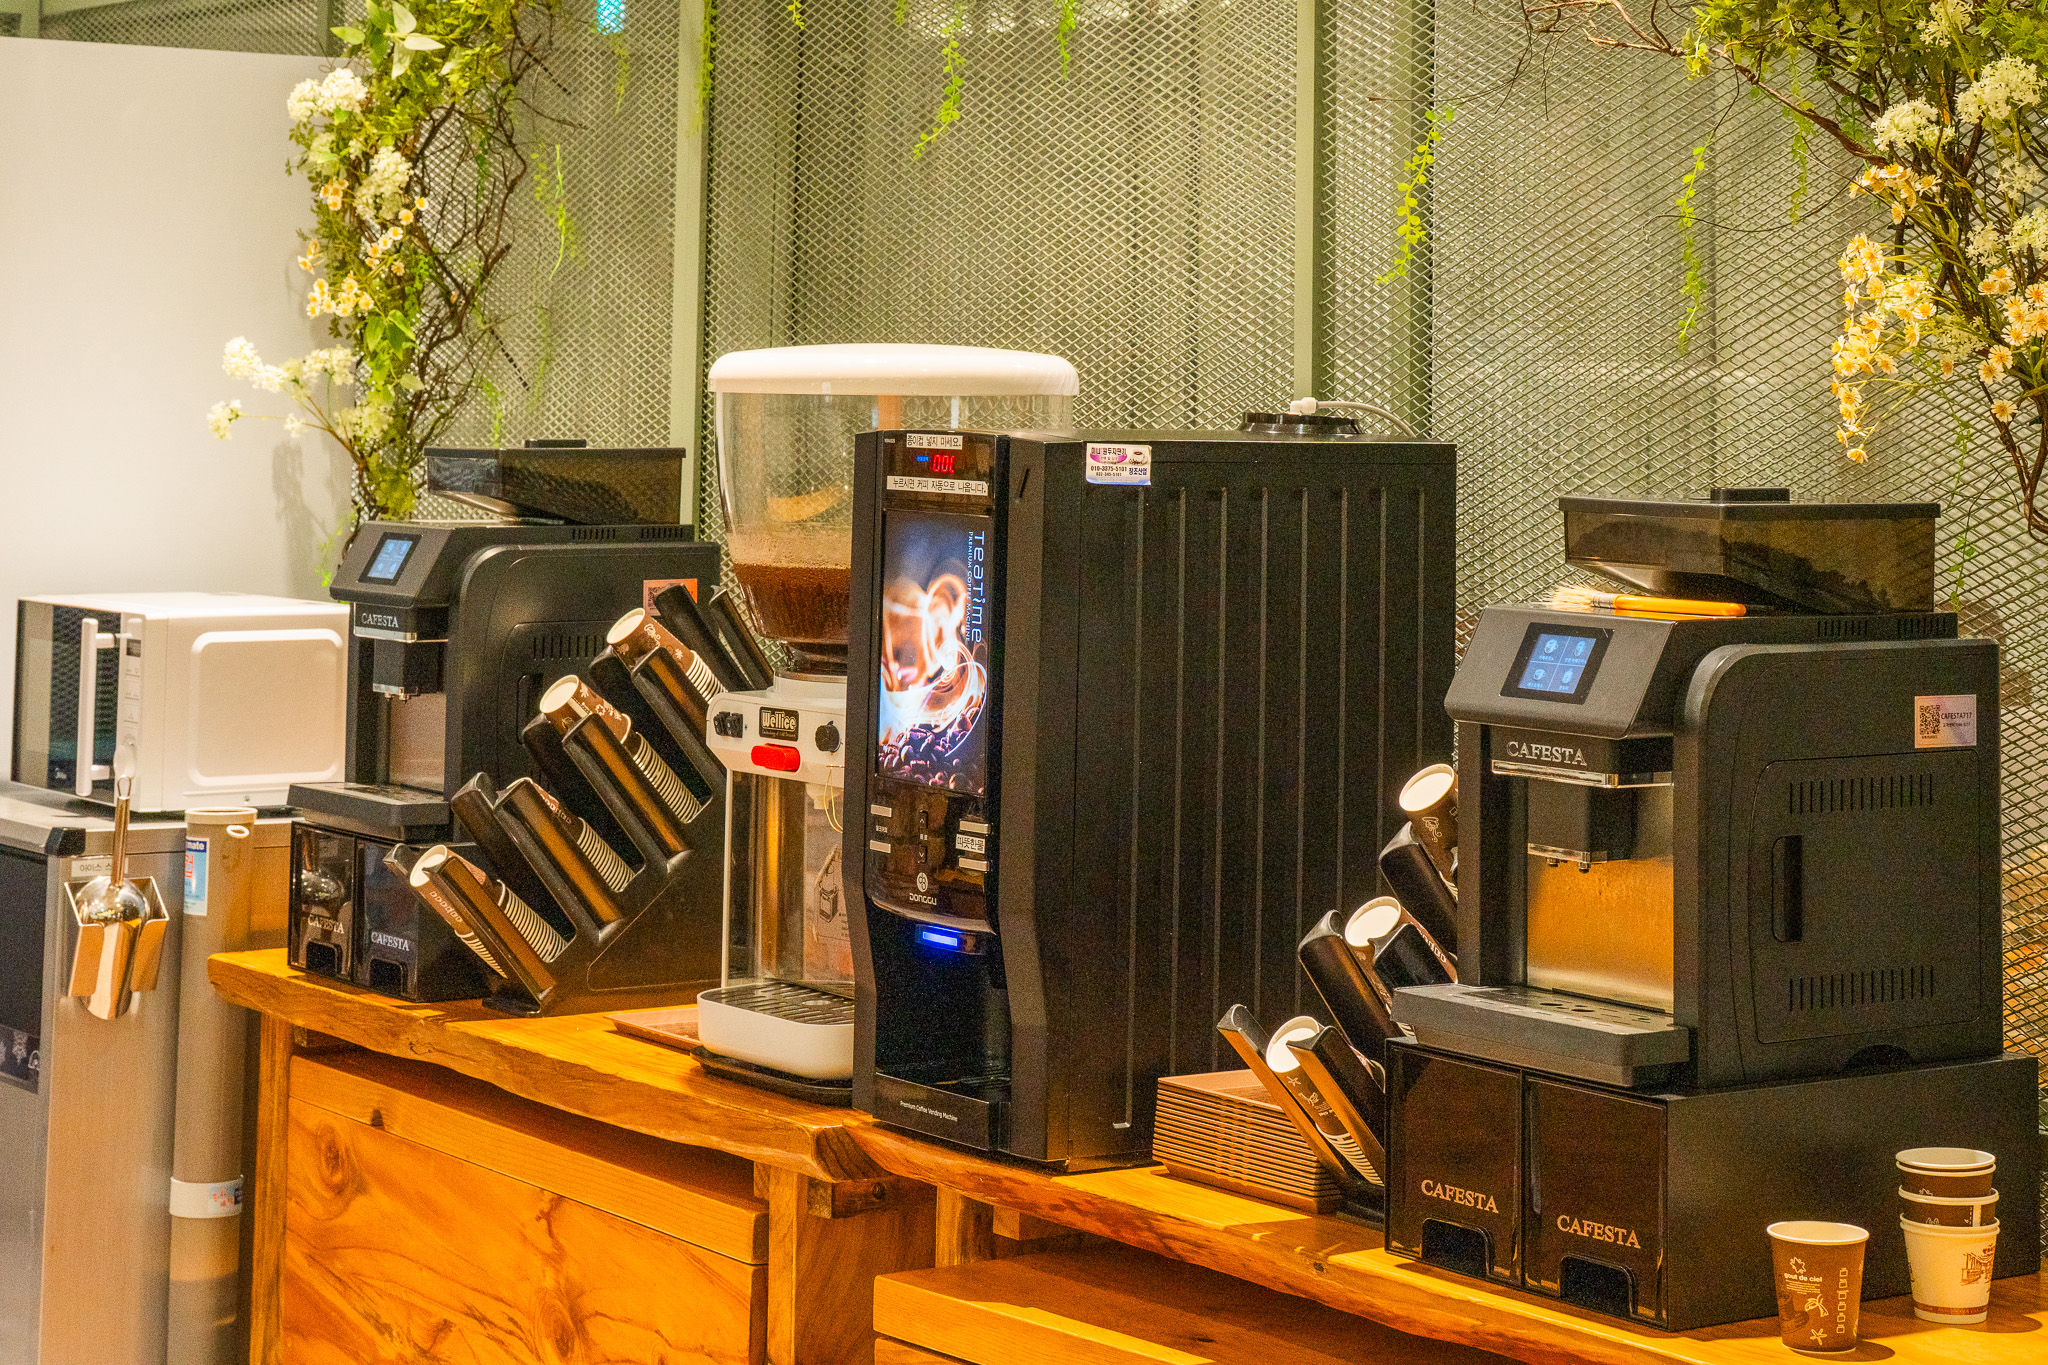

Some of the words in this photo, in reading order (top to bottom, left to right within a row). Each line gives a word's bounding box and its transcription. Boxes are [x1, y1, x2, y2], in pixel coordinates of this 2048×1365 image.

[907, 435, 924, 447] 종이컵
[926, 436, 938, 447] 넣지
[940, 436, 962, 448] 마세요.
[893, 478, 915, 490] 누르시면
[916, 479, 929, 490] 커피
[930, 480, 956, 492] 자동으로
[957, 481, 987, 494] 나옵니다.
[361, 612, 399, 628] CAFESTA
[761, 710, 797, 731] Wellice
[1506, 741, 1588, 766] CAFESTA
[308, 914, 344, 934] CAFESTA
[370, 931, 410, 952] CAFESTA
[900, 1100, 915, 1109] Premium
[1421, 1180, 1499, 1213] CAFESTA
[1557, 1215, 1641, 1249] CAFESTA
